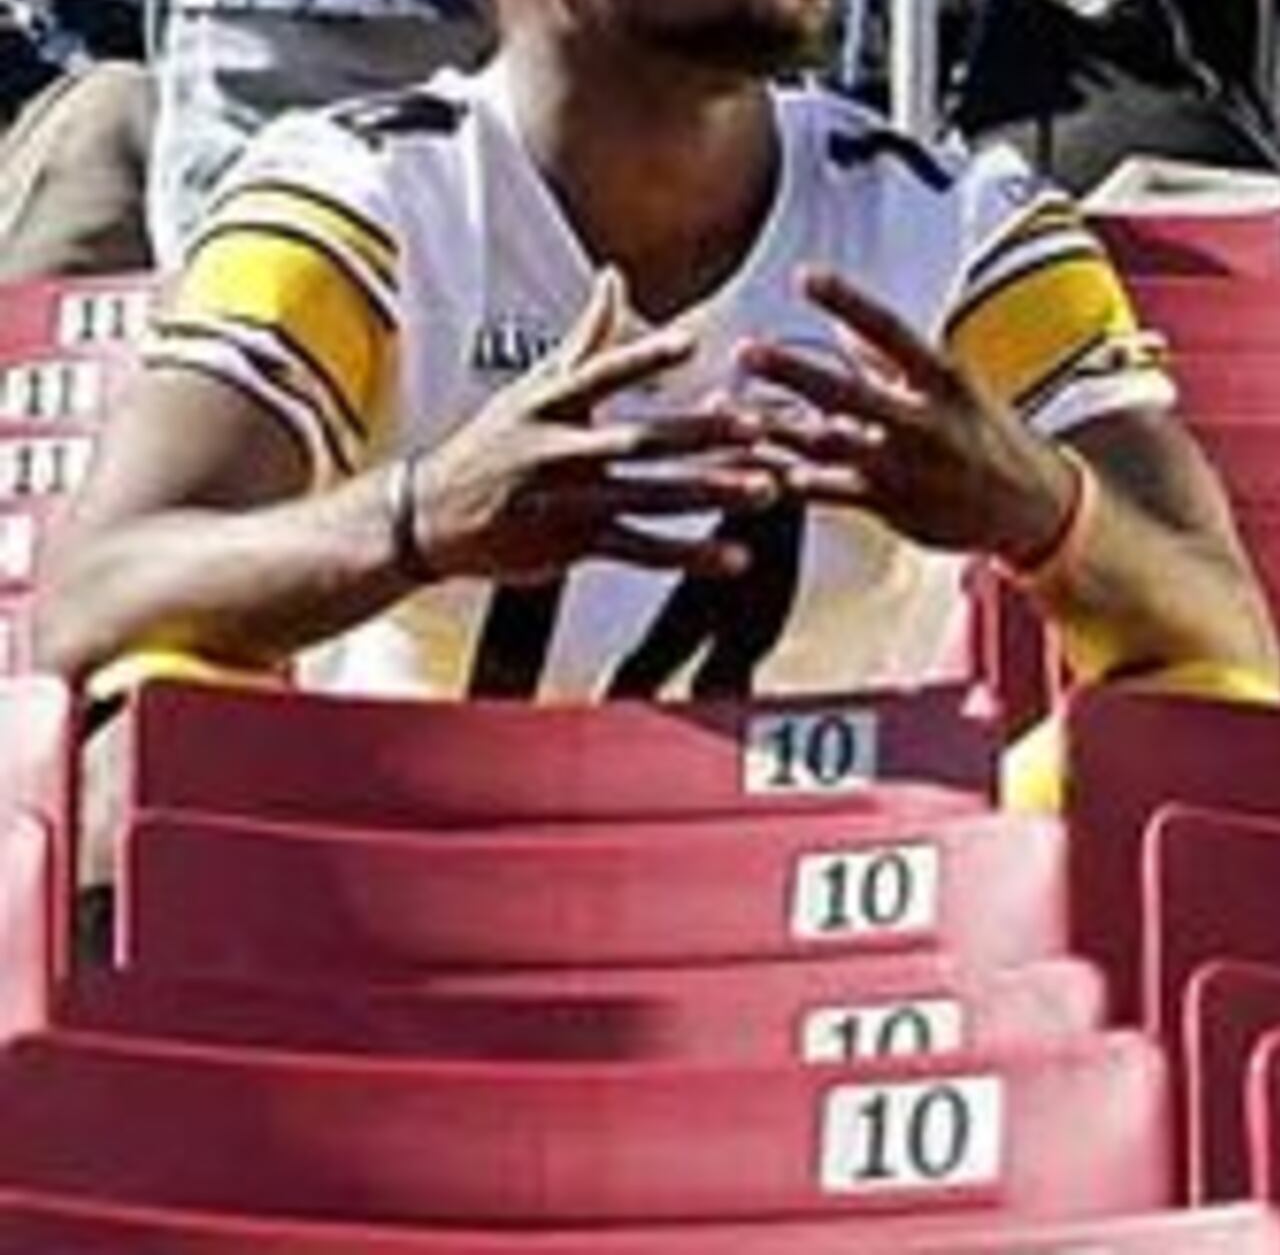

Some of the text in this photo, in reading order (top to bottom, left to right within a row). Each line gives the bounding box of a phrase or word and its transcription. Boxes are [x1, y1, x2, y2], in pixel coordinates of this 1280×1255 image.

[78, 297, 127, 341] 11
[26, 368, 75, 415] 11
[13, 446, 66, 494] 11
[766, 716, 855, 786] 10
[818, 856, 912, 932] 10
[854, 1086, 970, 1180] 10
